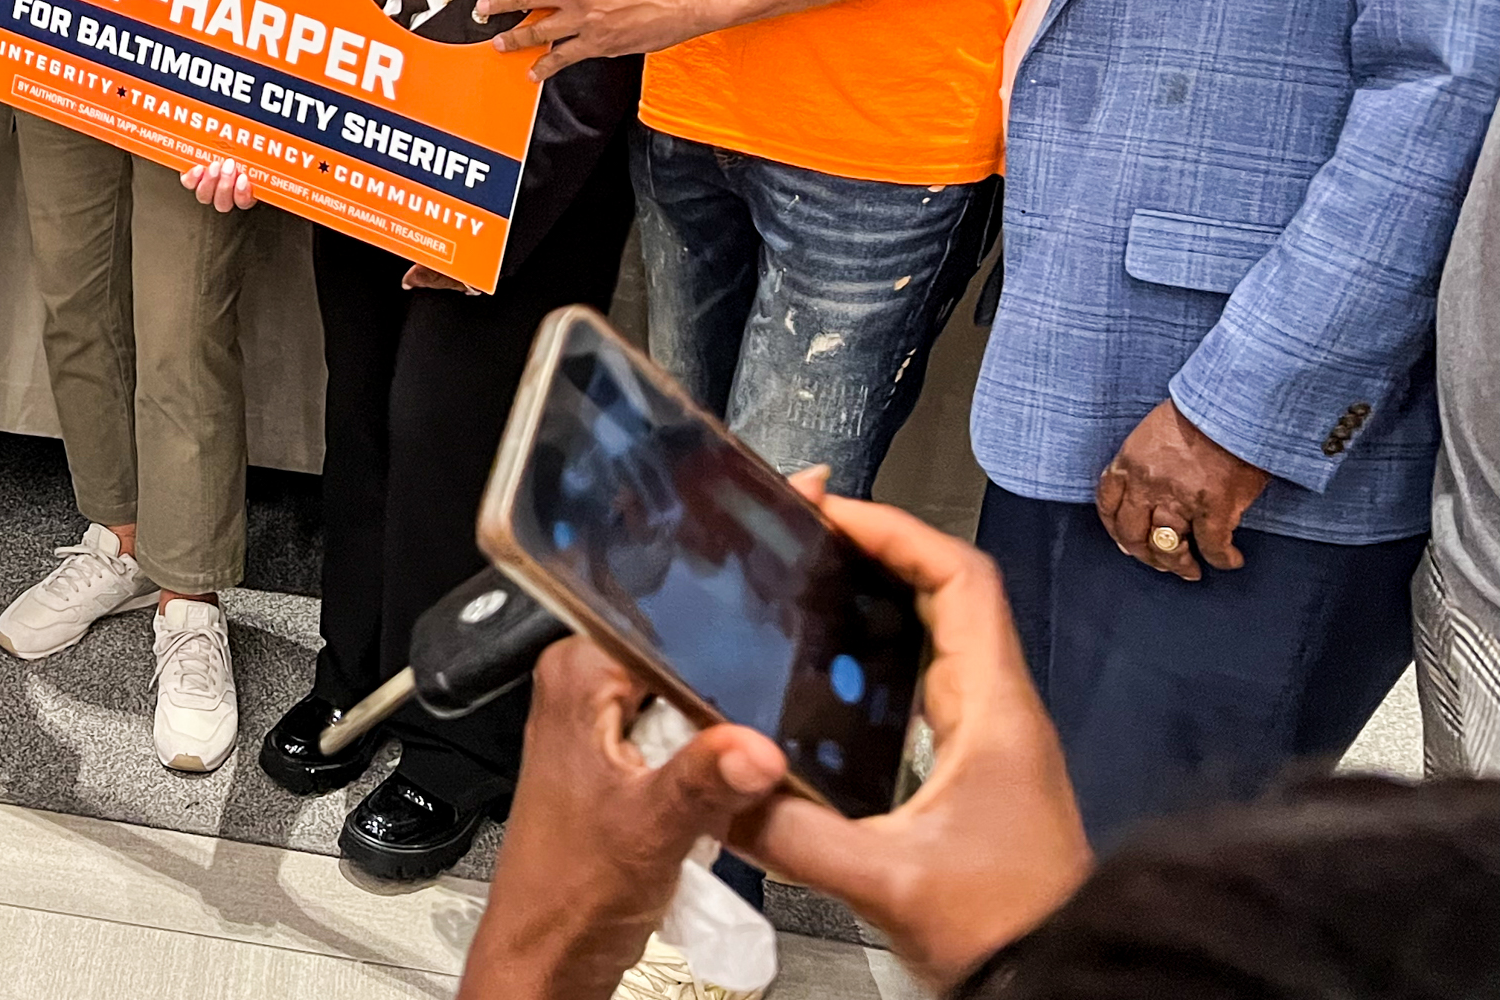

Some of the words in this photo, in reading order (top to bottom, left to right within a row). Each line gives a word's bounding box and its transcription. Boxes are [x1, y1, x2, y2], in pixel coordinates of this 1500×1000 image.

[0, 40, 113, 94] INTEGRITY
[131, 88, 315, 168] TRANSPARENCY
[334, 164, 484, 236] COMMUNITY
[17, 80, 32, 92] BY
[29, 84, 78, 112] AUTHORITY:
[78, 100, 115, 126] SABRINA
[116, 113, 175, 149] TAPP-HARPER
[176, 142, 195, 156] FOR
[248, 166, 270, 182] CITY
[270, 174, 310, 202] SHERIFF,
[311, 191, 347, 213] HARISH
[347, 205, 389, 231] RAMANI,
[390, 221, 448, 255] TREASURER.
[76, 15, 256, 104] BALTIMORE
[260, 81, 339, 132] CITY
[341, 111, 491, 188] SHERIFF
